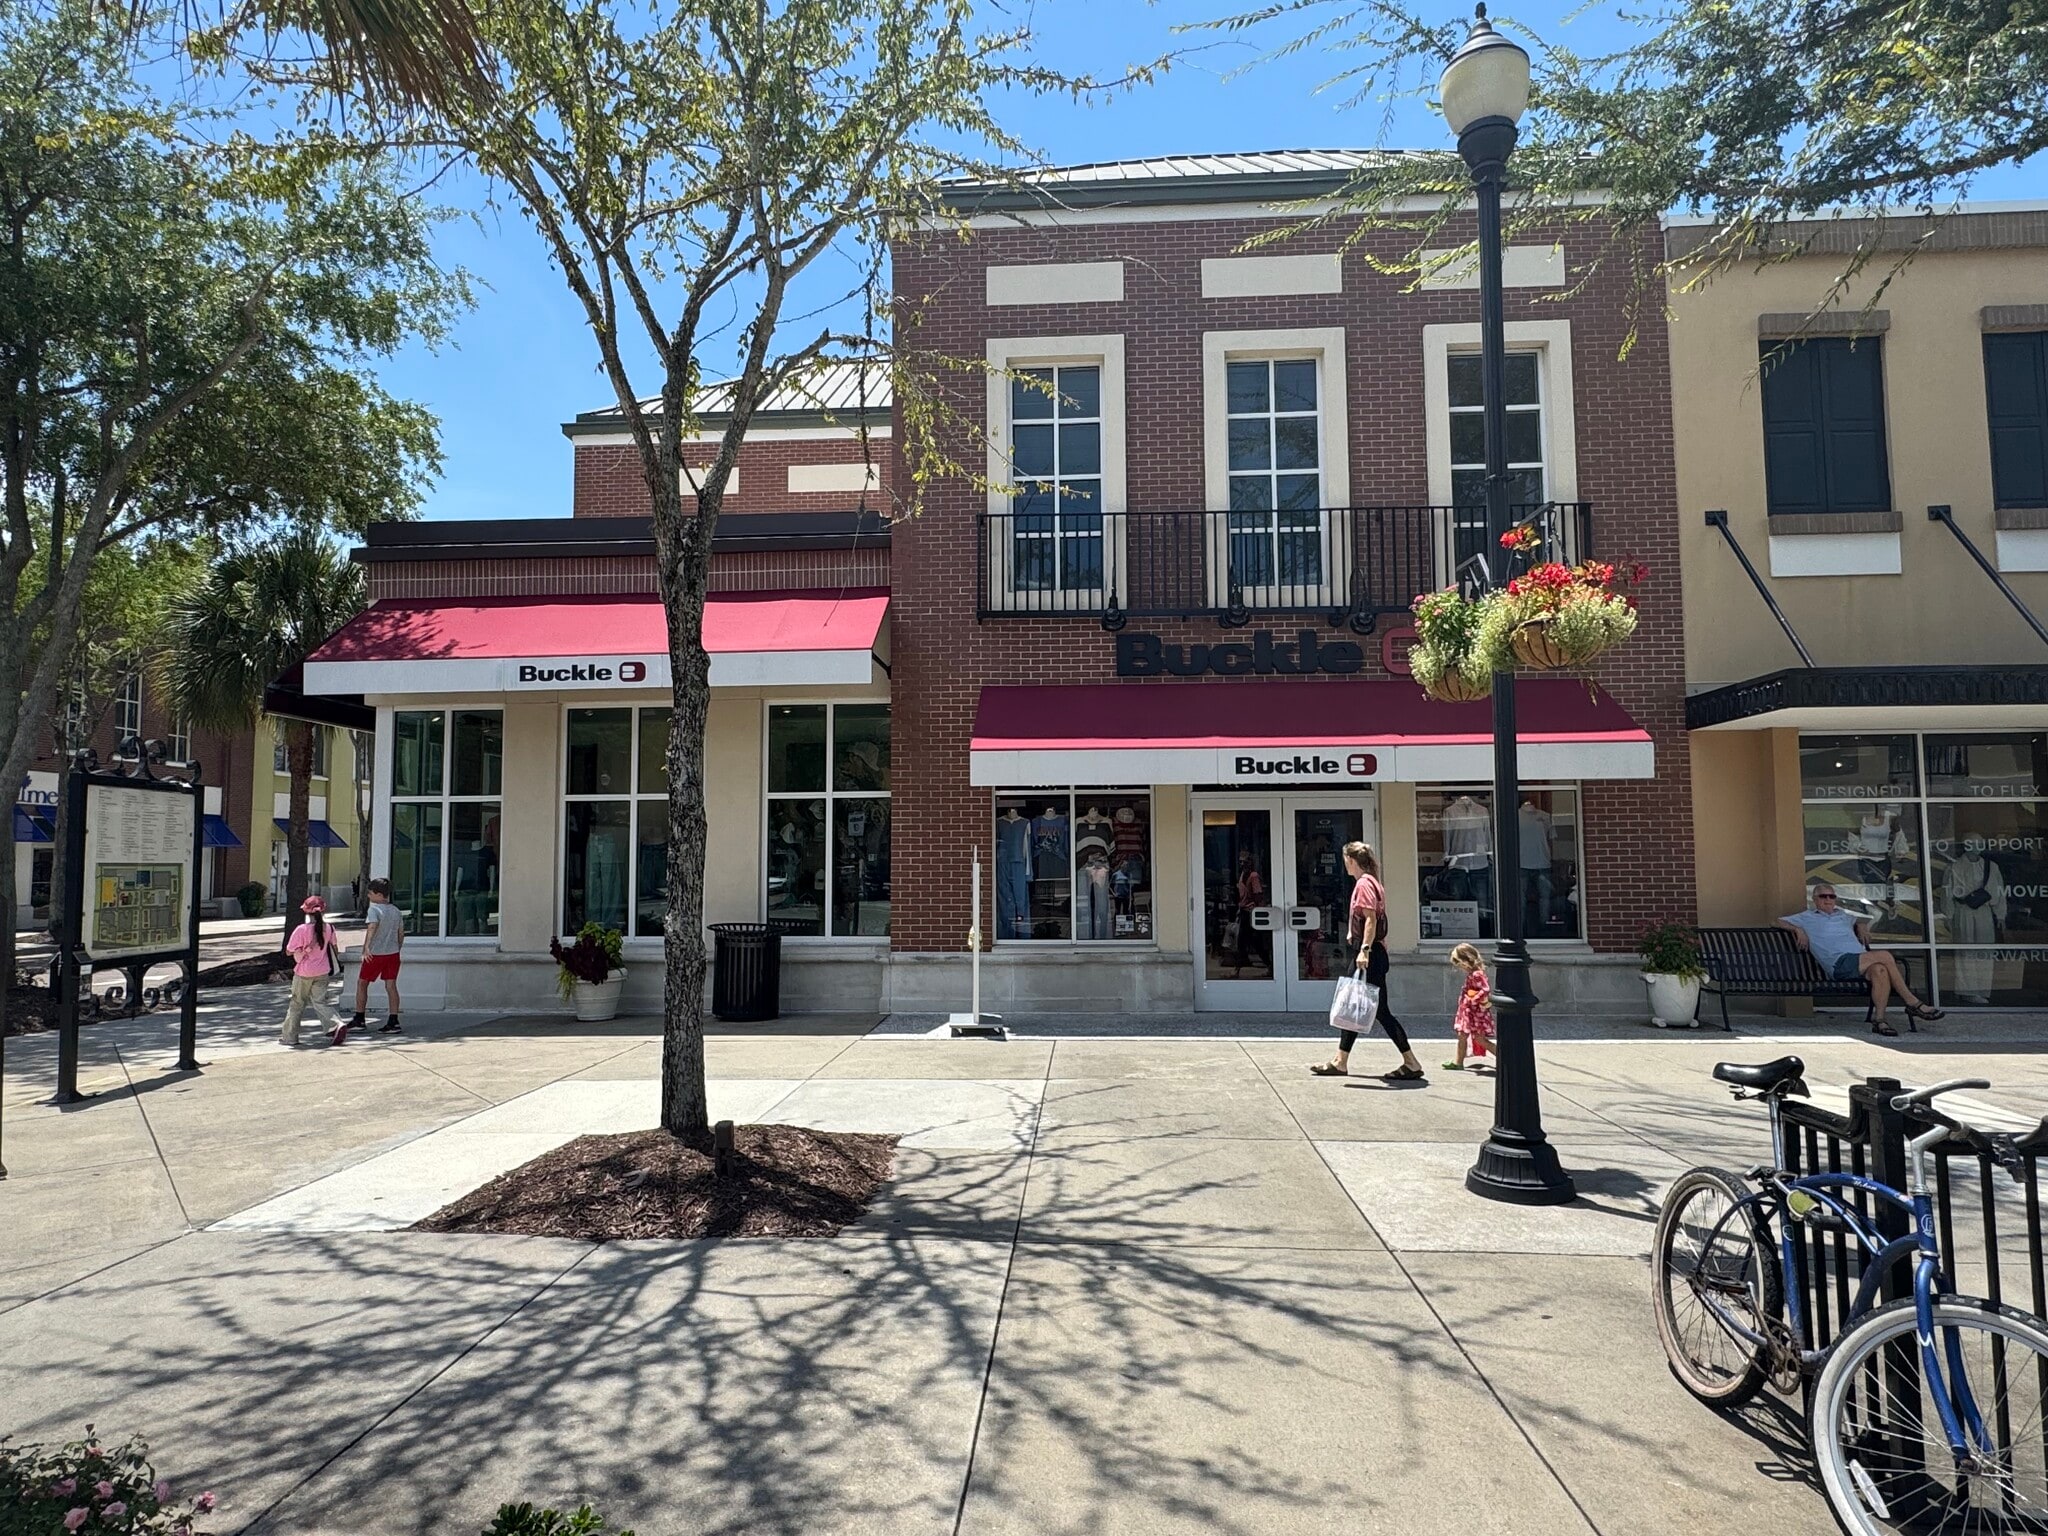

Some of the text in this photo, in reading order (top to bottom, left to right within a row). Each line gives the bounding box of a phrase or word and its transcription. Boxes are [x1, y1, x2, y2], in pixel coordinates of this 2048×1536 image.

[1116, 630, 1364, 676] Buckle
[519, 664, 613, 682] Buckle
[1235, 756, 1340, 775] Buckle
[1815, 785, 2041, 797] DESIGNED TO FLEX
[1963, 837, 2045, 851] SUPPORT
[1997, 885, 2048, 897] MOVE
